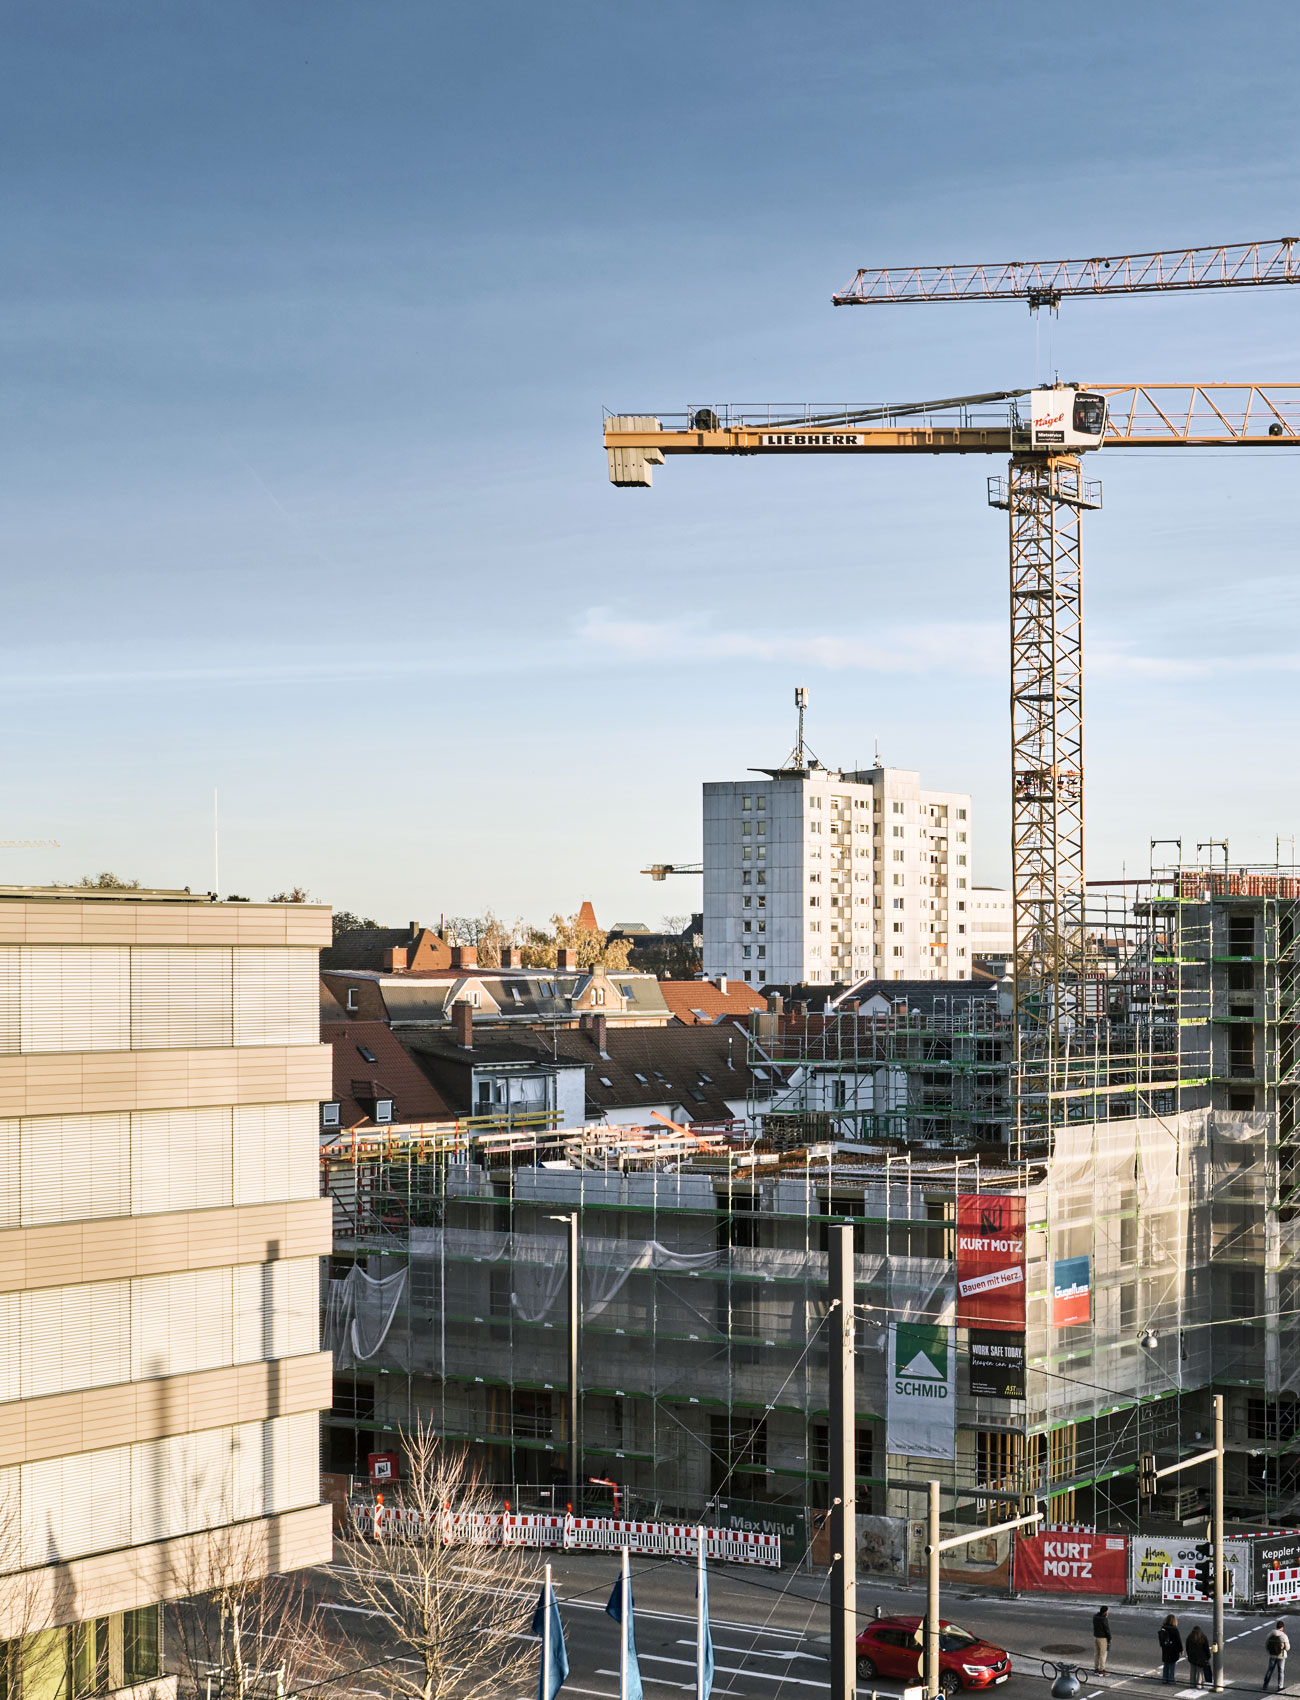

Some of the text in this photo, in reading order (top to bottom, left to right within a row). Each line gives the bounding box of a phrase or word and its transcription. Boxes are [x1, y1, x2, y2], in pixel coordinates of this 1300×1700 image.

[767, 435, 858, 445] LIEBHERR
[960, 1238, 1023, 1253] KURT MOTZ
[962, 1271, 1021, 1293] Bauen mit Herz.
[972, 1344, 1023, 1359] WORK SAFE TODAY.
[895, 1381, 948, 1398] SCHMID
[730, 1515, 795, 1536] Max Wild
[1044, 1541, 1092, 1560] KURT
[1262, 1546, 1295, 1560] Keppler
[1043, 1560, 1093, 1579] MOTZ
